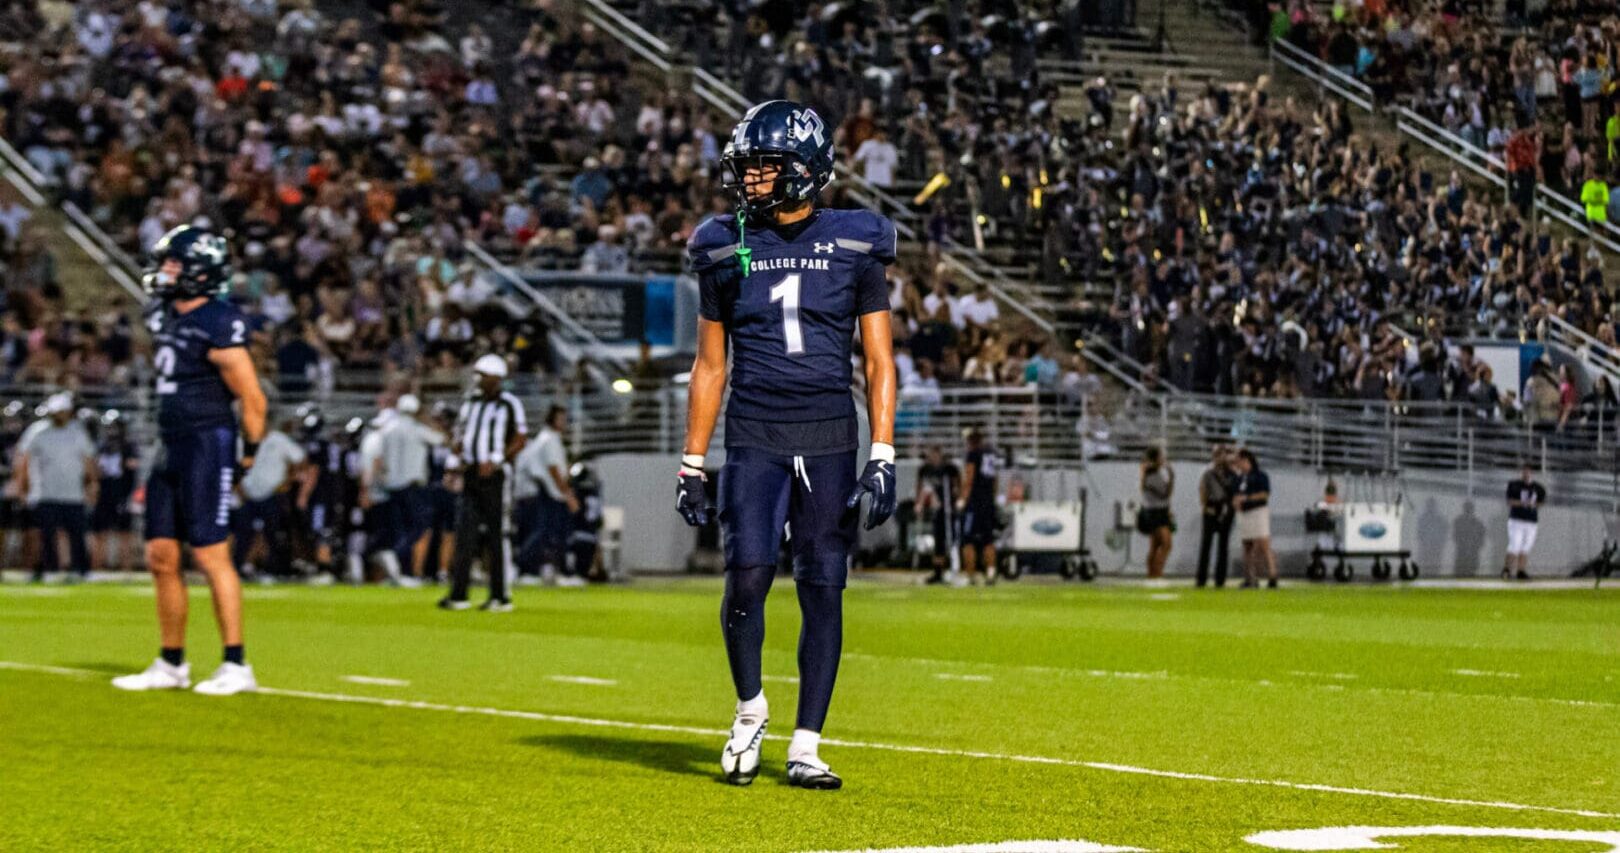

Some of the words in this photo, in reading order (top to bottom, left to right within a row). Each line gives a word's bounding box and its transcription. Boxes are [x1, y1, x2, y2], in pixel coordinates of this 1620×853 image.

[751, 258, 797, 272] COLLEGE
[800, 258, 830, 270] PARK
[231, 319, 246, 343] 2
[769, 273, 805, 355] 1
[154, 345, 179, 395] 2
